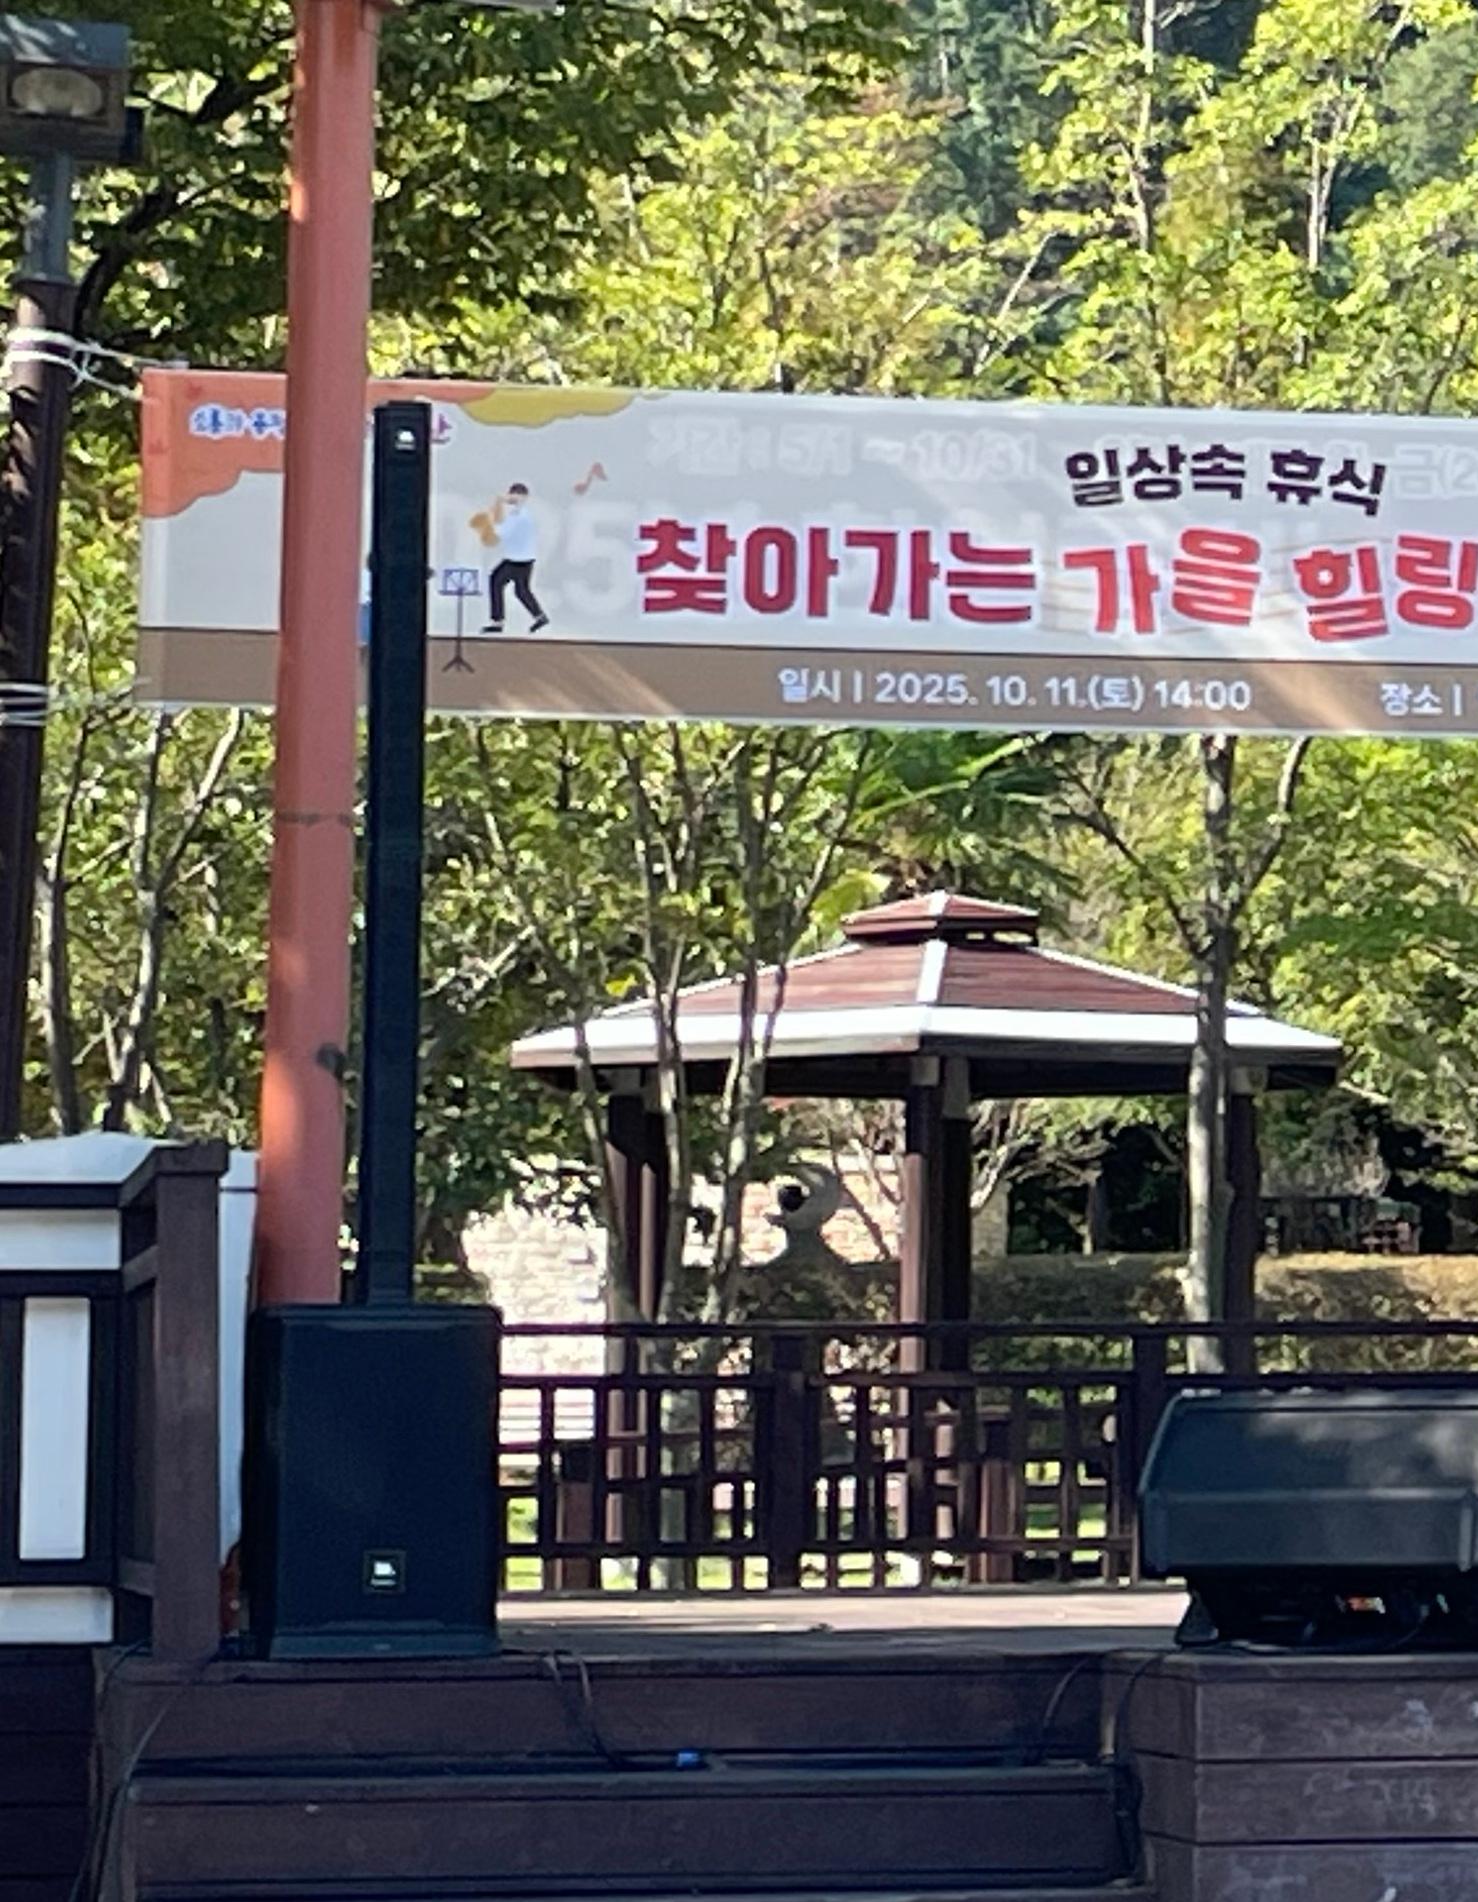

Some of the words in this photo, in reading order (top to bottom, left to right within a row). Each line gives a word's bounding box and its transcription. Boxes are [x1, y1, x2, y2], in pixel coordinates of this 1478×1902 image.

[1065, 443, 1246, 508] 일상속
[1266, 449, 1387, 517] 휴식
[636, 519, 1037, 624] 찾아가는
[1063, 527, 1262, 634] 가을
[778, 667, 841, 704] 일시
[874, 671, 979, 706] 2025.
[985, 674, 1037, 707] 10.
[1154, 680, 1252, 712] 14:00
[1379, 681, 1443, 717] 장소
